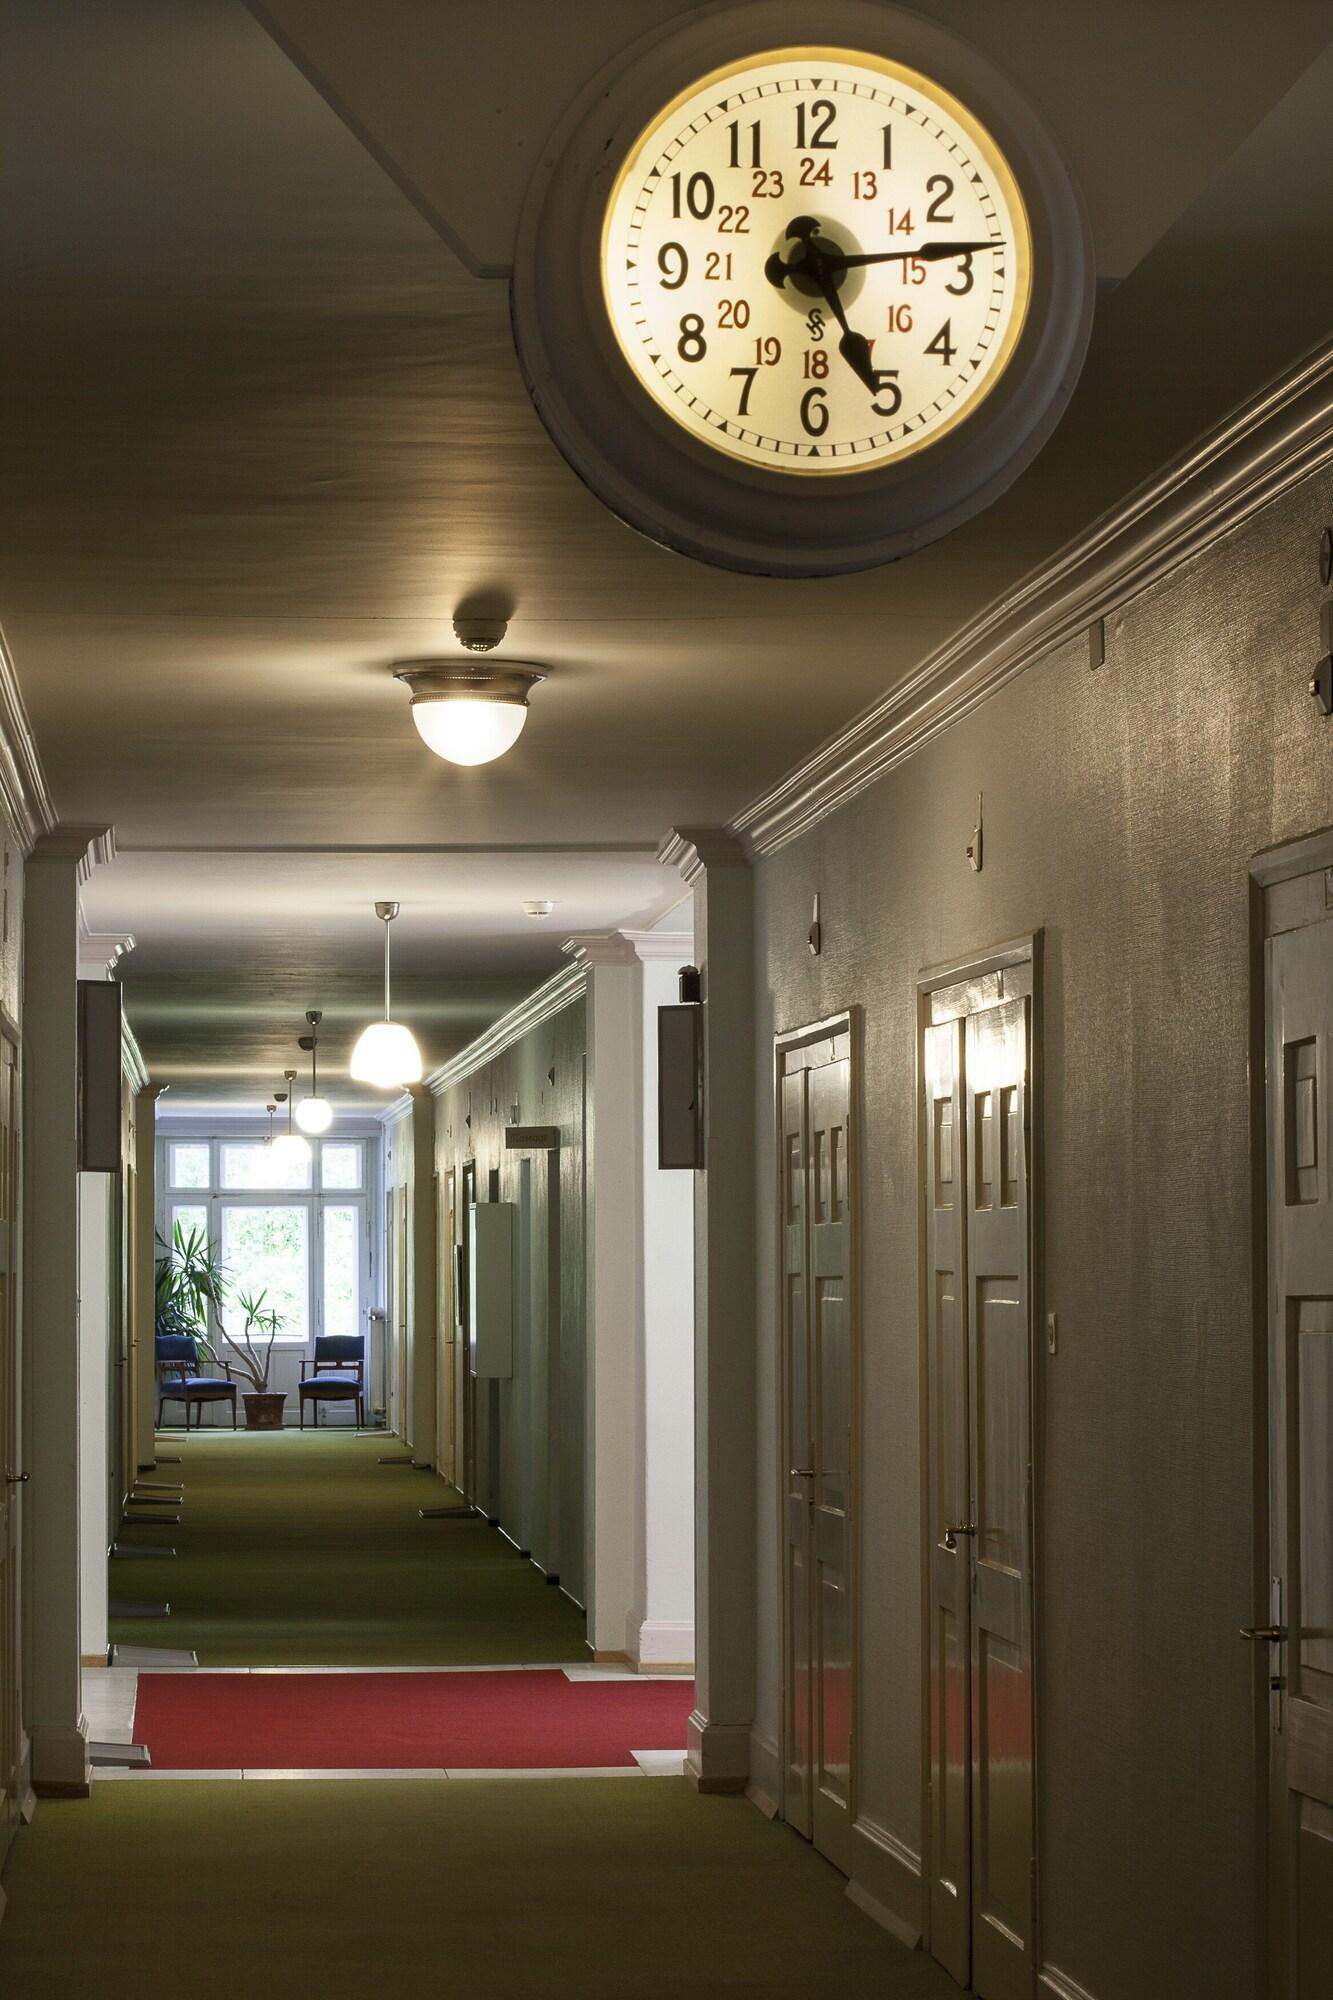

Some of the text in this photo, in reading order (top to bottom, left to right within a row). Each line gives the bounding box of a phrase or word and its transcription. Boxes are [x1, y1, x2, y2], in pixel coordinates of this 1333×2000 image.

[727, 120, 762, 168] 11
[795, 100, 838, 149] 12
[880, 123, 892, 171] 1
[752, 171, 784, 198] 23
[800, 157, 833, 186] 24
[854, 171, 877, 200] 13
[670, 172, 714, 220] 10
[926, 175, 954, 223] 2
[718, 205, 749, 233] 22
[887, 208, 914, 235] 14
[658, 242, 688, 290] 9
[705, 252, 731, 280] 21
[902, 257, 927, 285] 15
[945, 252, 974, 296] 3
[718, 300, 750, 329] 20
[888, 304, 912, 333] 16
[678, 314, 707, 363] 8
[754, 337, 781, 366] 19
[923, 318, 957, 366] 4
[803, 350, 829, 379] 18
[730, 368, 759, 416] 7
[800, 387, 829, 437] 6
[871, 370, 903, 417] 5
